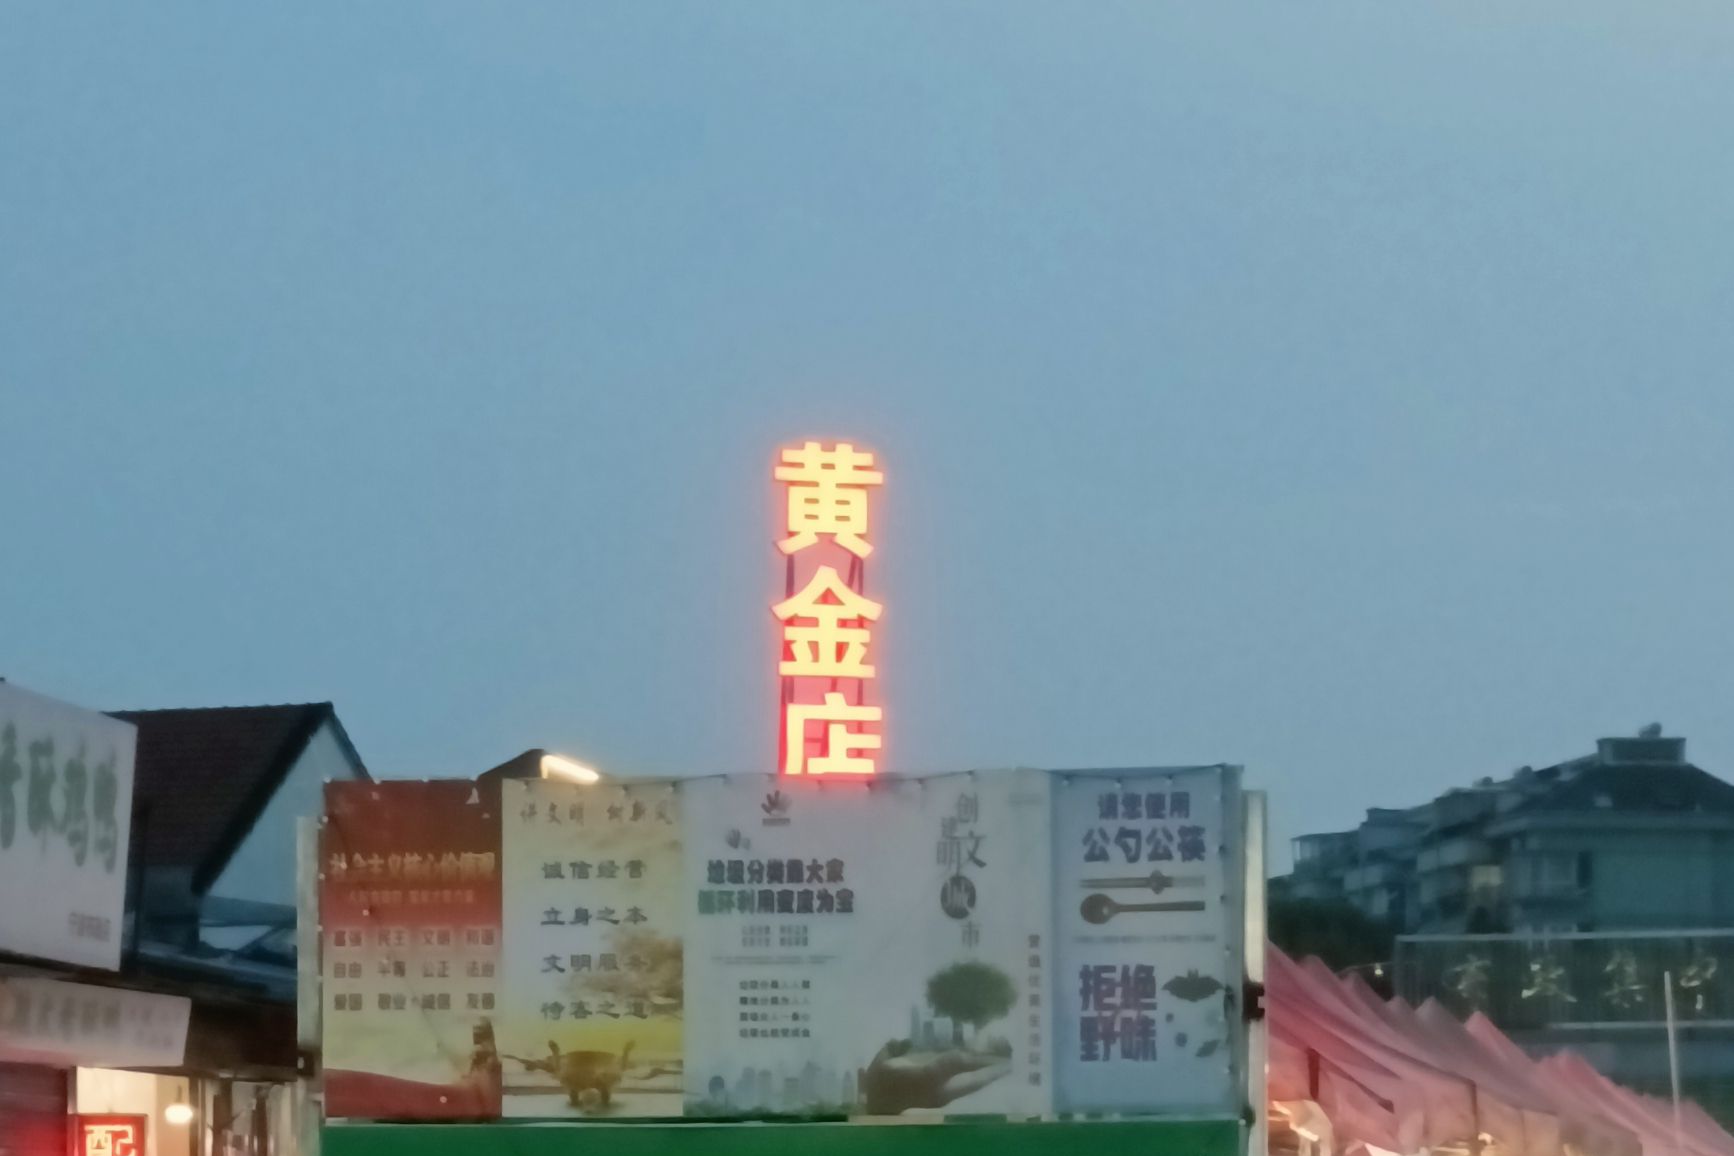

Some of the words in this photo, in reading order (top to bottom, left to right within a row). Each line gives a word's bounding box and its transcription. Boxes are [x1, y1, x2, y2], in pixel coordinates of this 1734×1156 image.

[771, 441, 883, 775] 黄金店
[1081, 826, 1206, 863] 公勺公筷
[540, 905, 648, 926] 立身之本
